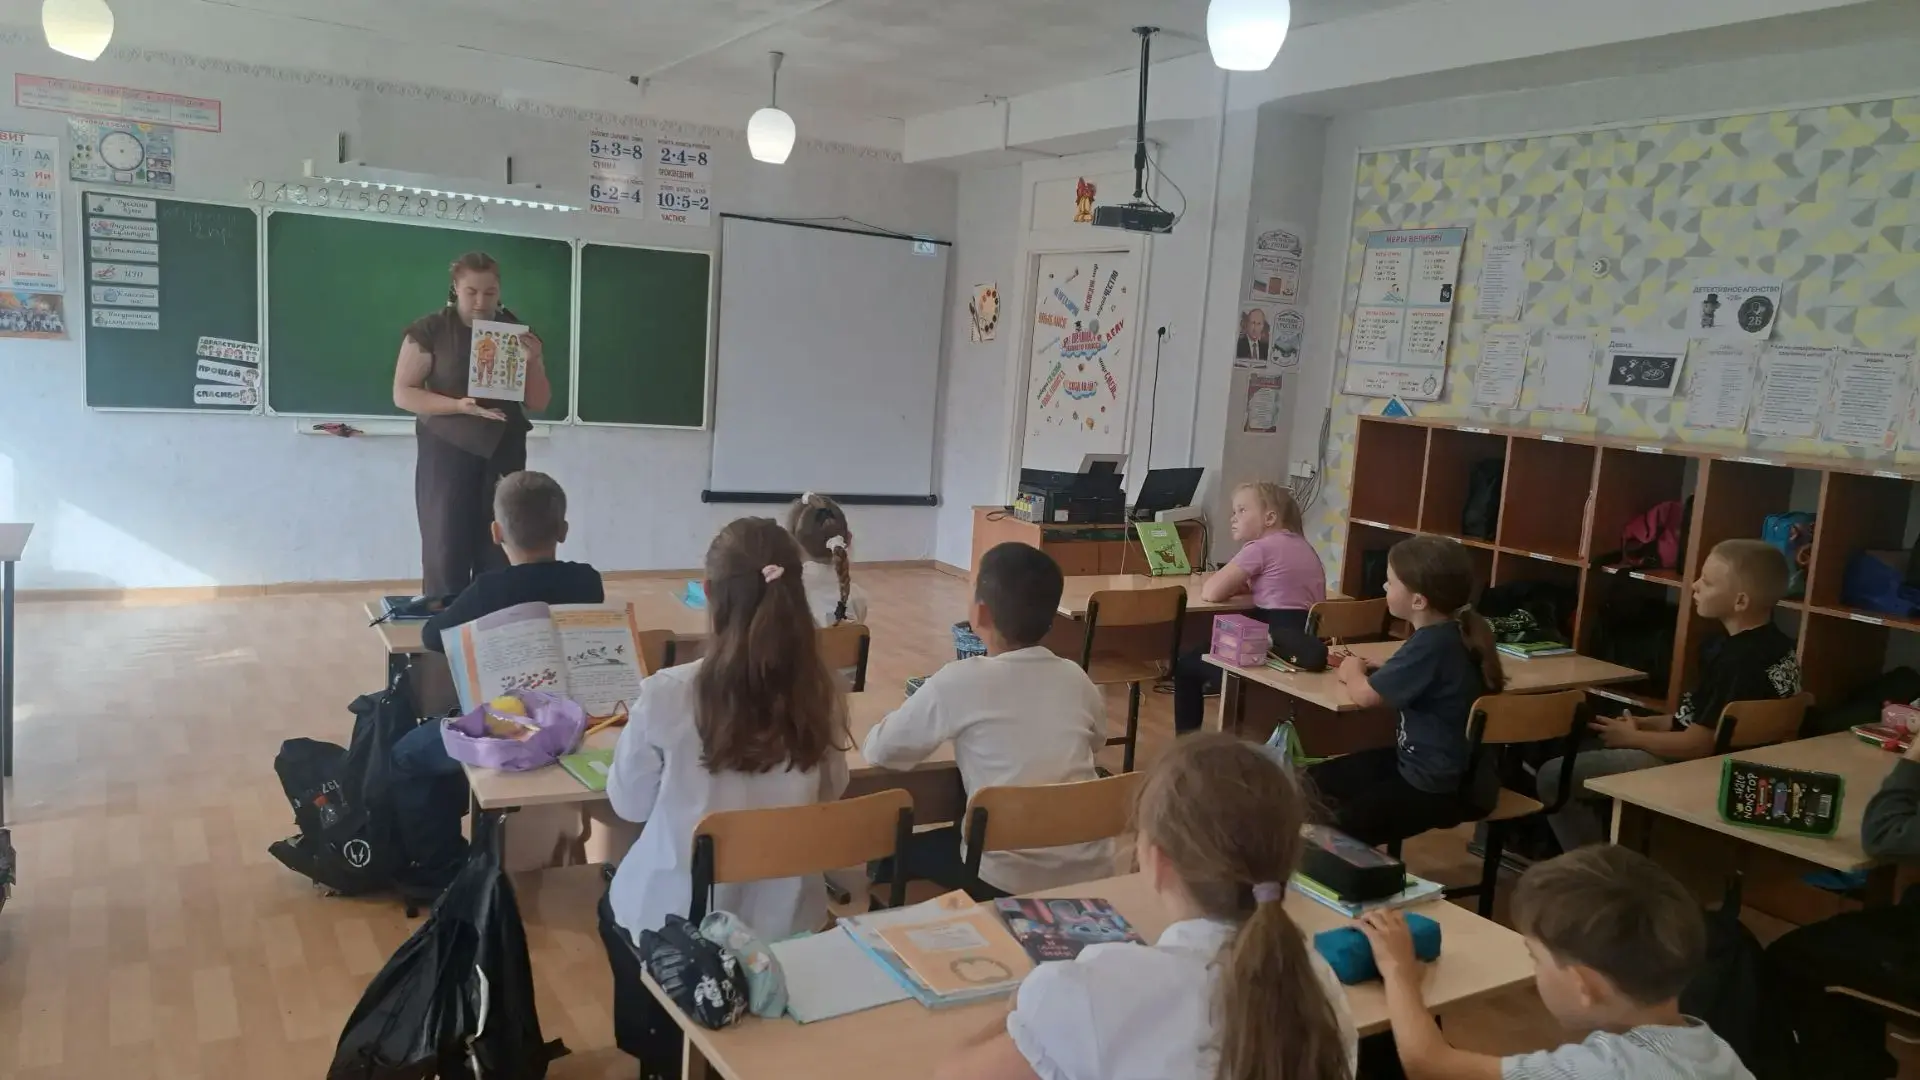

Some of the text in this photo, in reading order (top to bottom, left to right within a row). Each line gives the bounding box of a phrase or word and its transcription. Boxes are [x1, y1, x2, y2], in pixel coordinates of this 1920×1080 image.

[590, 139, 642, 159] 5+3=8
[378, 194, 389, 213] 6
[398, 196, 408, 214] 7
[417, 198, 428, 216] 8
[1693, 286, 1742, 294] ДЕТЕКТИВНОЕ
[196, 390, 240, 399] СПАСИБО
[1743, 772, 1759, 820] NONSTOP
